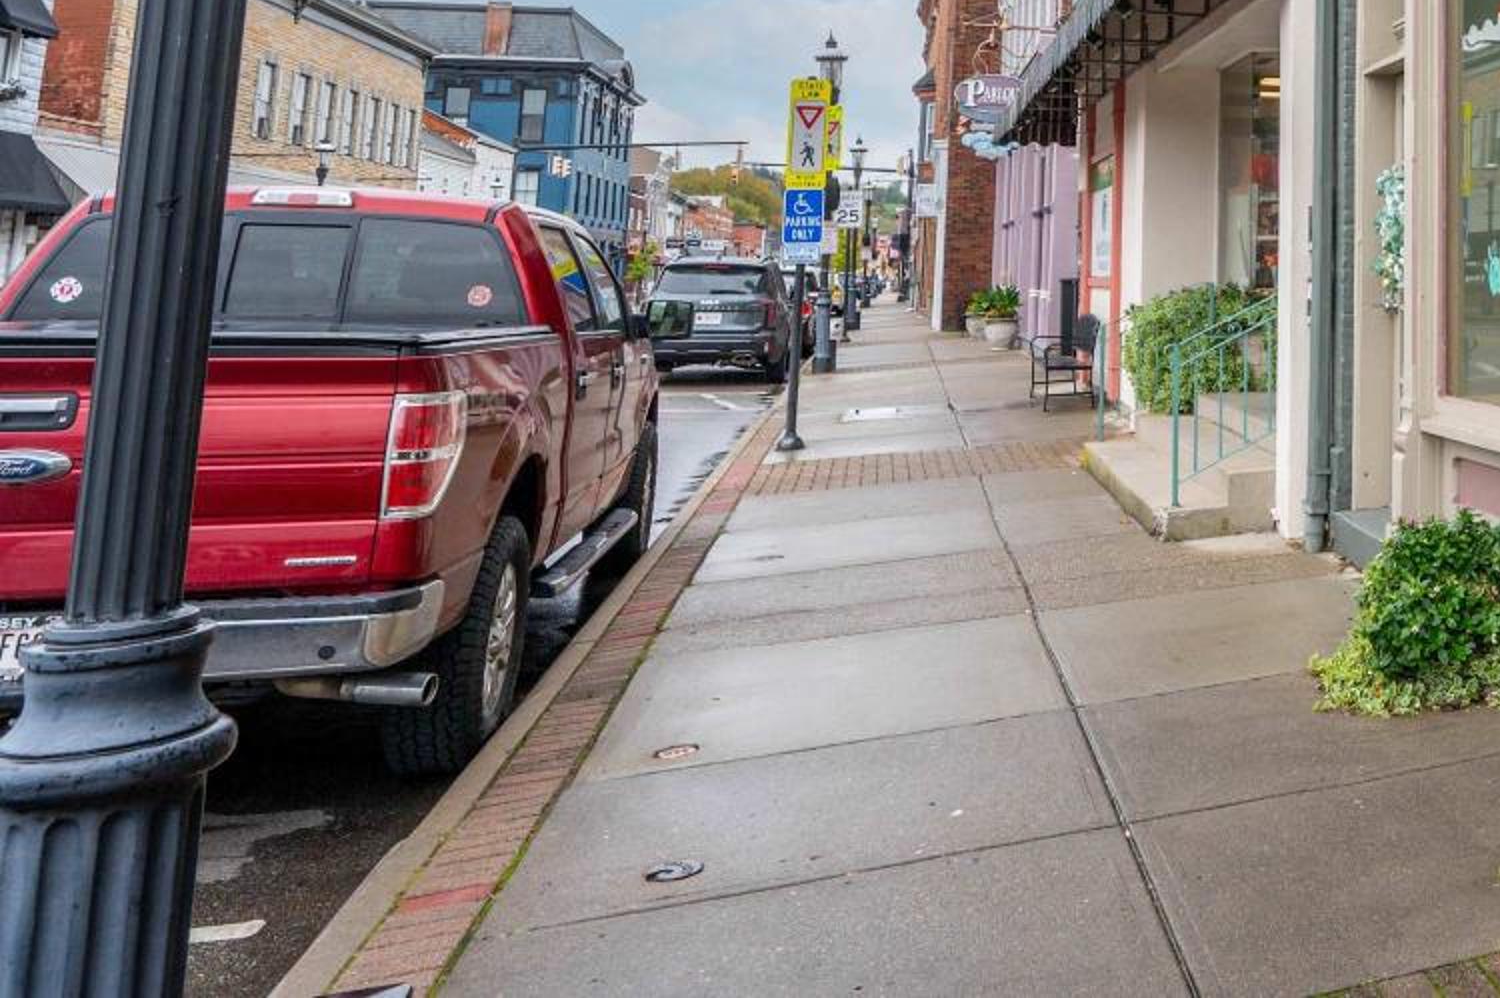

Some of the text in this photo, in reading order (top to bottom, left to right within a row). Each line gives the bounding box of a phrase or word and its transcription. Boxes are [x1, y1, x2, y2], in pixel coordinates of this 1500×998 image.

[785, 215, 821, 227] PARKING
[837, 209, 859, 223] 25
[791, 228, 814, 240] ONLY
